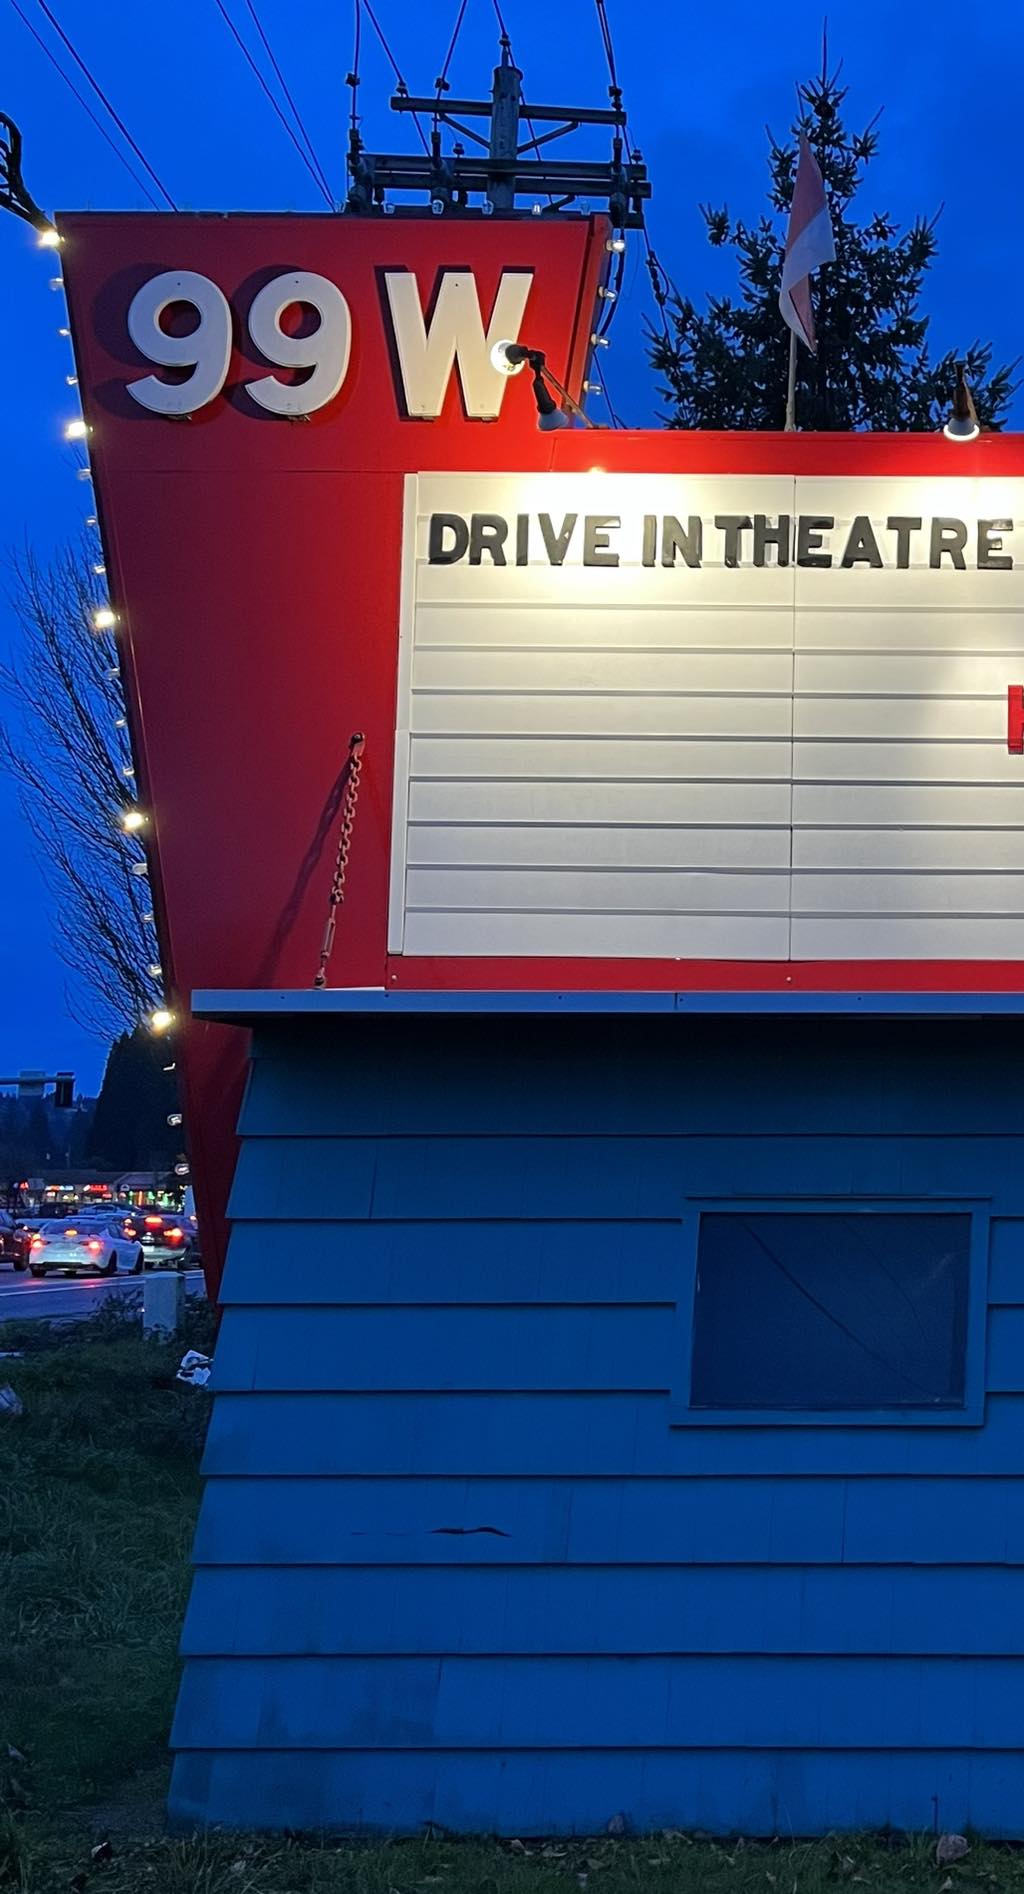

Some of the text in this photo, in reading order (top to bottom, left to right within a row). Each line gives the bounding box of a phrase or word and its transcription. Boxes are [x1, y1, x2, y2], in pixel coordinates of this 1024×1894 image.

[428, 512, 1013, 570] DRIVE IN THEATRE
